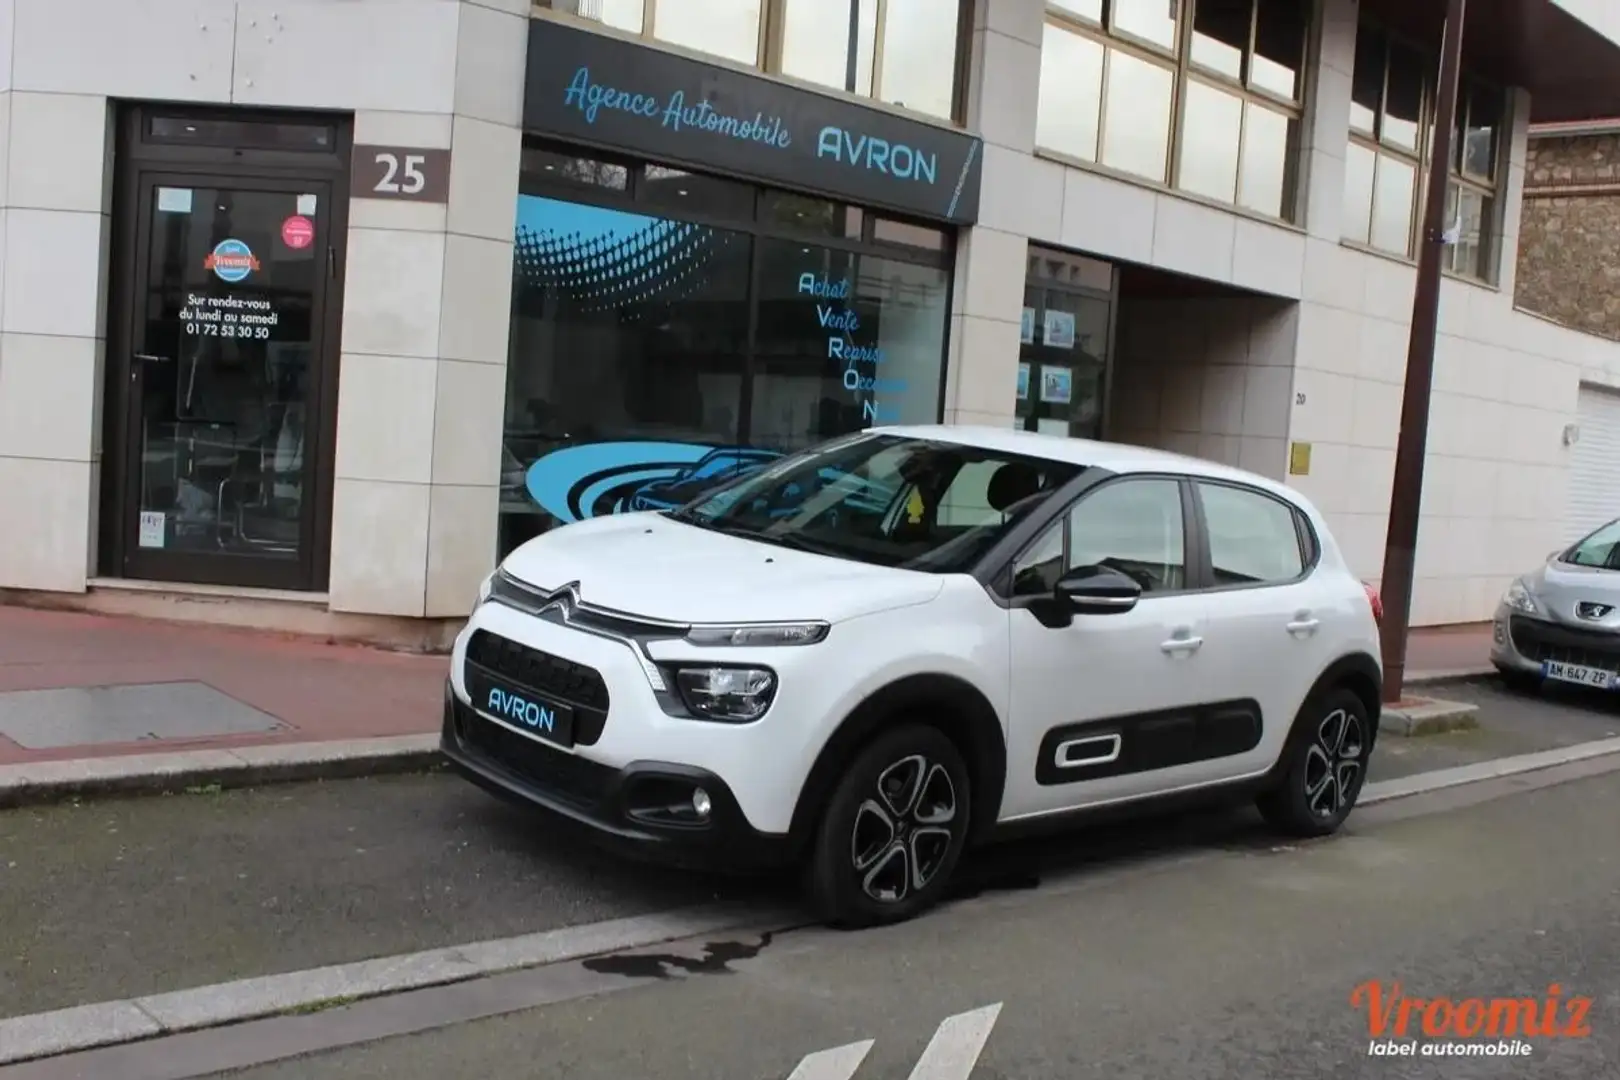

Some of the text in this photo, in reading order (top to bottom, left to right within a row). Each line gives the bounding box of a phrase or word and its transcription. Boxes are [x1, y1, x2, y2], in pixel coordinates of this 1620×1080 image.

[564, 67, 792, 148] Agence Automobile
[818, 126, 936, 184] AVRON
[373, 154, 425, 193] 25
[799, 272, 850, 298] Achat
[188, 293, 271, 310] Sur rendez-vous
[179, 307, 278, 325] du lundi au samedi
[816, 304, 860, 330] Vente
[186, 323, 269, 339] 01 72 53 30 50
[488, 688, 553, 732] AVRON
